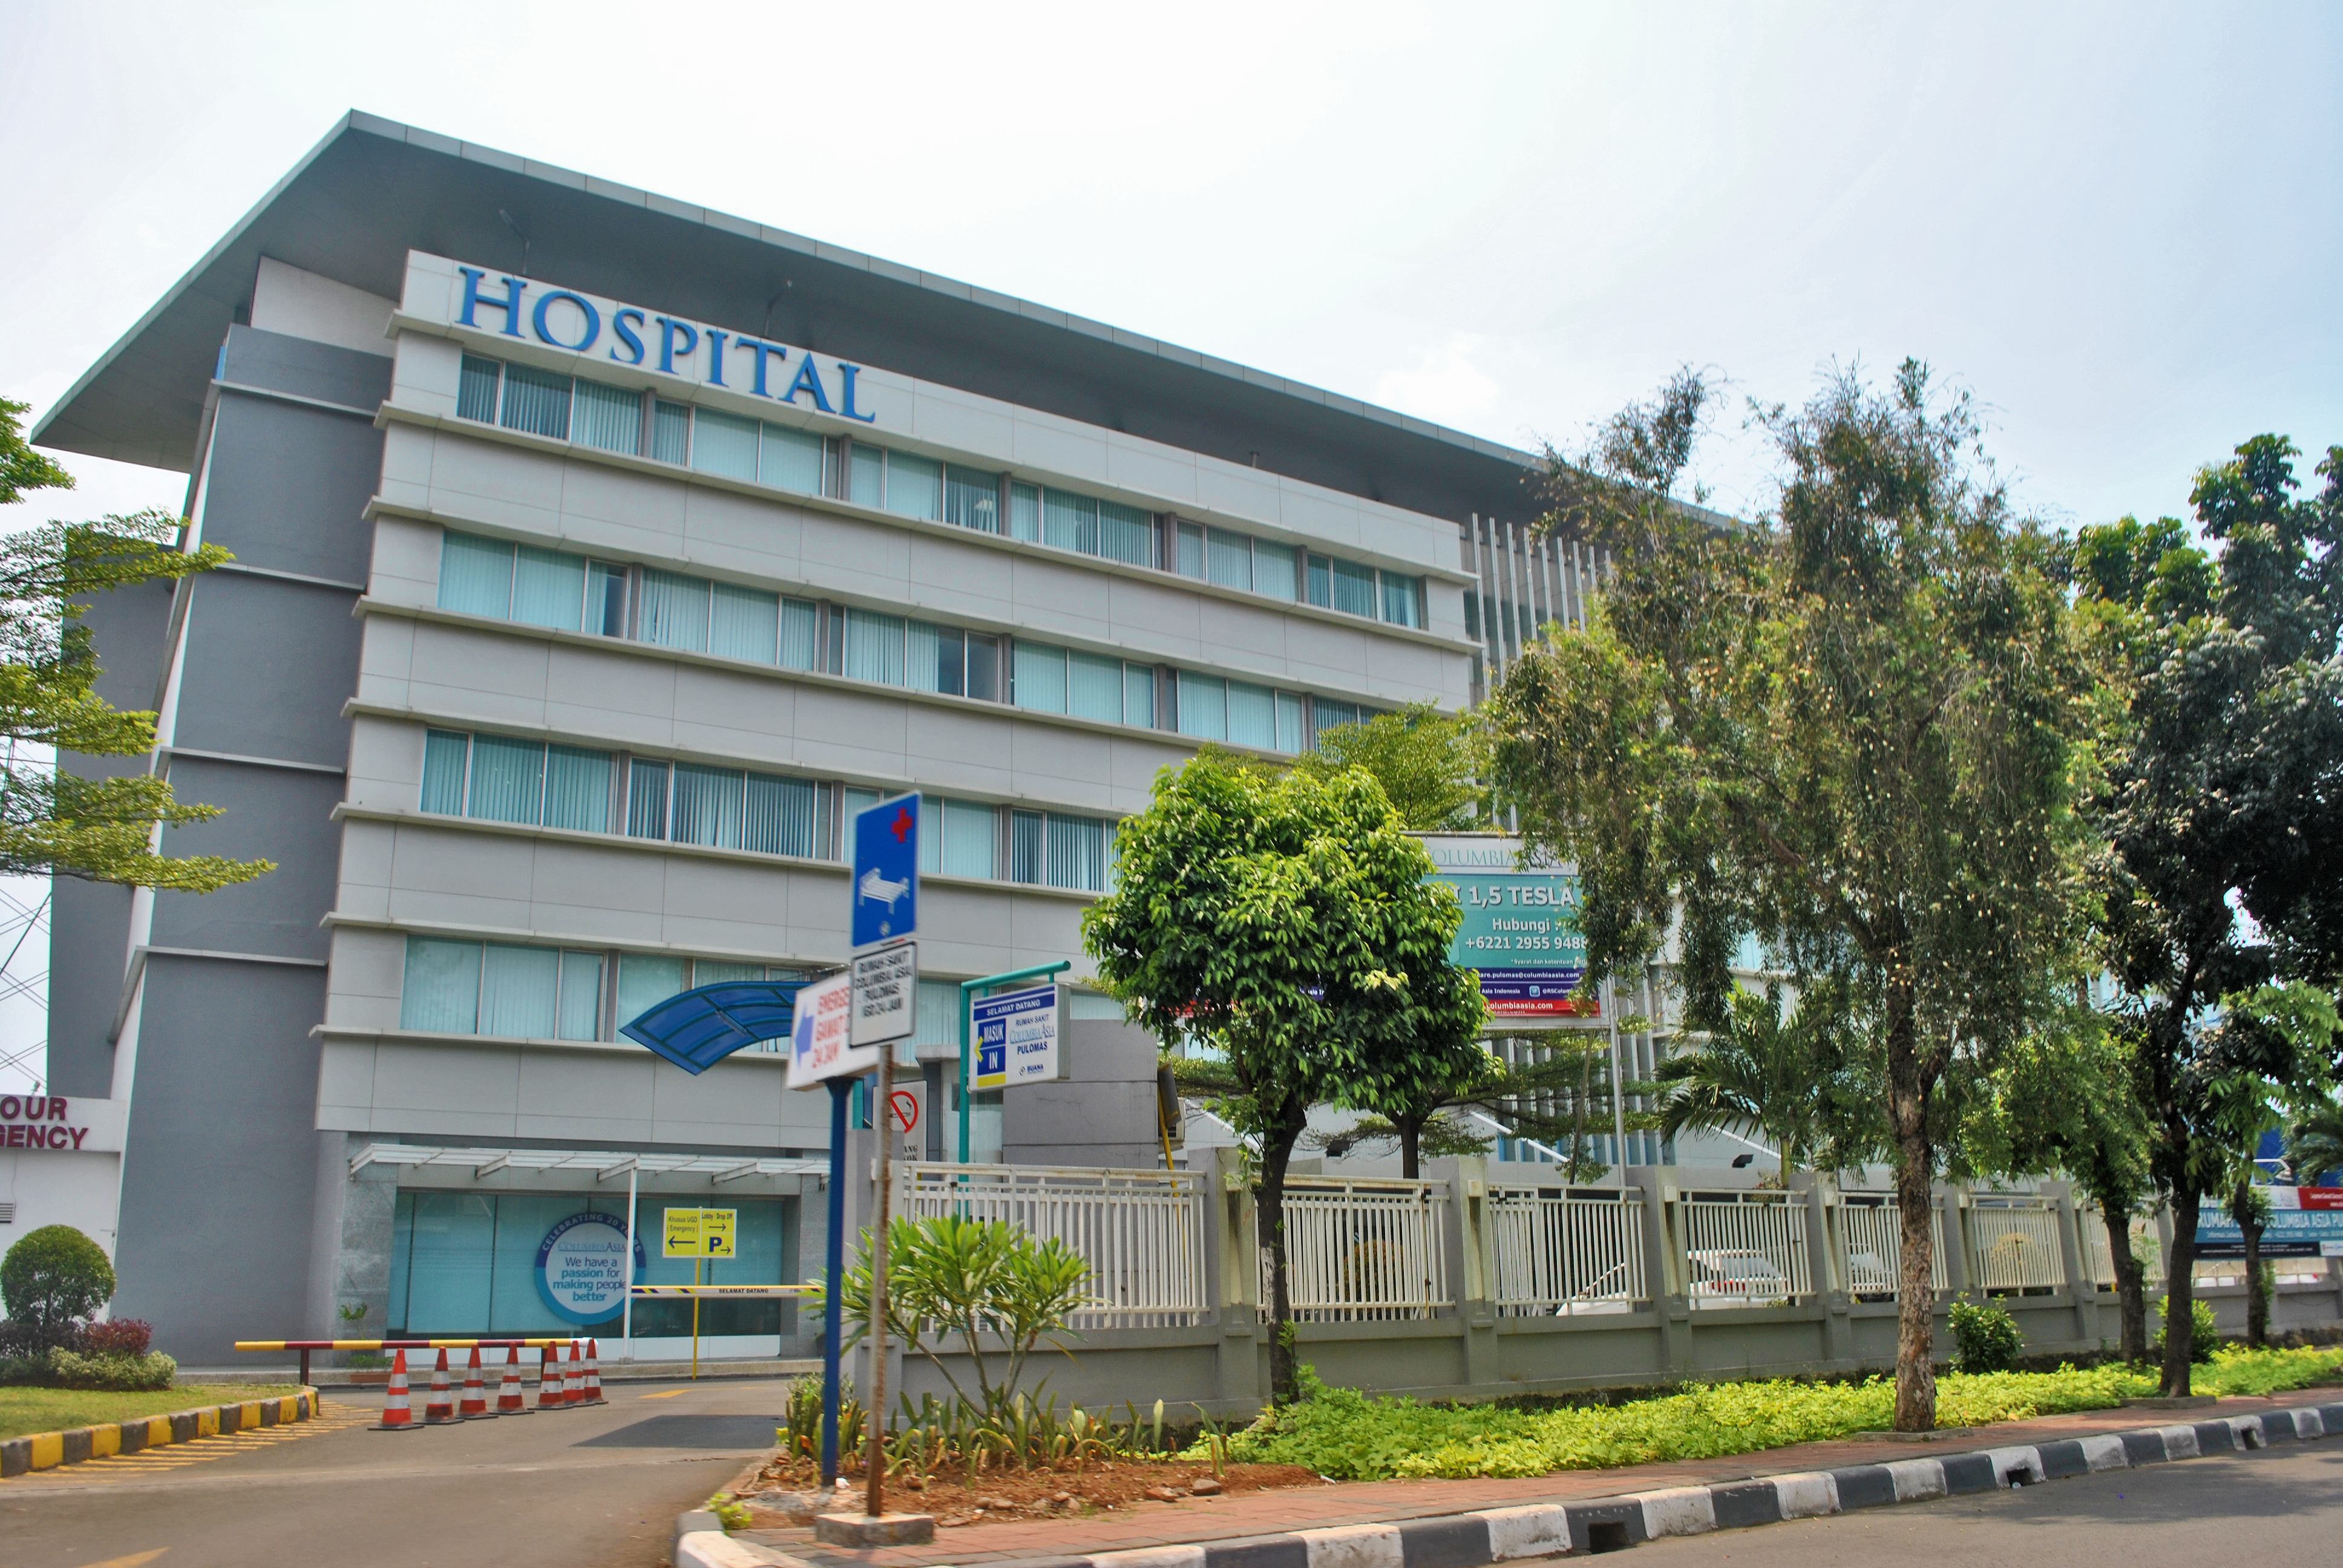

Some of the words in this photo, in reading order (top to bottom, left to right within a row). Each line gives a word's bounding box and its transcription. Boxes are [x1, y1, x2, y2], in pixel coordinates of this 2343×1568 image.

[454, 266, 875, 422] HOSPITAL
[1426, 846, 1516, 866] OLUMBIA
[1469, 886, 1502, 909] 1,5
[1507, 886, 1575, 906] TESLA
[1492, 918, 1550, 934] Hubungi
[1465, 936, 1511, 950] +6221
[1515, 936, 1550, 950] 2955
[1554, 936, 1588, 950] 9488
[986, 1004, 1015, 1016] SELAMAT
[1015, 999, 1041, 1011] DATANG
[1016, 1018, 1034, 1027] RUMAH
[1034, 1014, 1049, 1023] SAKIT
[983, 1024, 1004, 1043] MASUK
[1017, 1041, 1047, 1054] PULOMAS
[989, 1051, 998, 1070] IN
[0, 1125, 88, 1149] ENCY
[702, 1212, 713, 1221] Lobby
[542, 1214, 603, 1251] CELEBRATING
[607, 1216, 618, 1226] 20
[558, 1243, 606, 1252] COLUMBIA
[709, 1236, 723, 1252] P
[565, 1256, 582, 1267] We
[585, 1256, 608, 1267] have
[562, 1268, 603, 1279] passion
[607, 1268, 620, 1277] for
[552, 1279, 593, 1292] making
[596, 1279, 626, 1291] people
[573, 1292, 607, 1301] better
